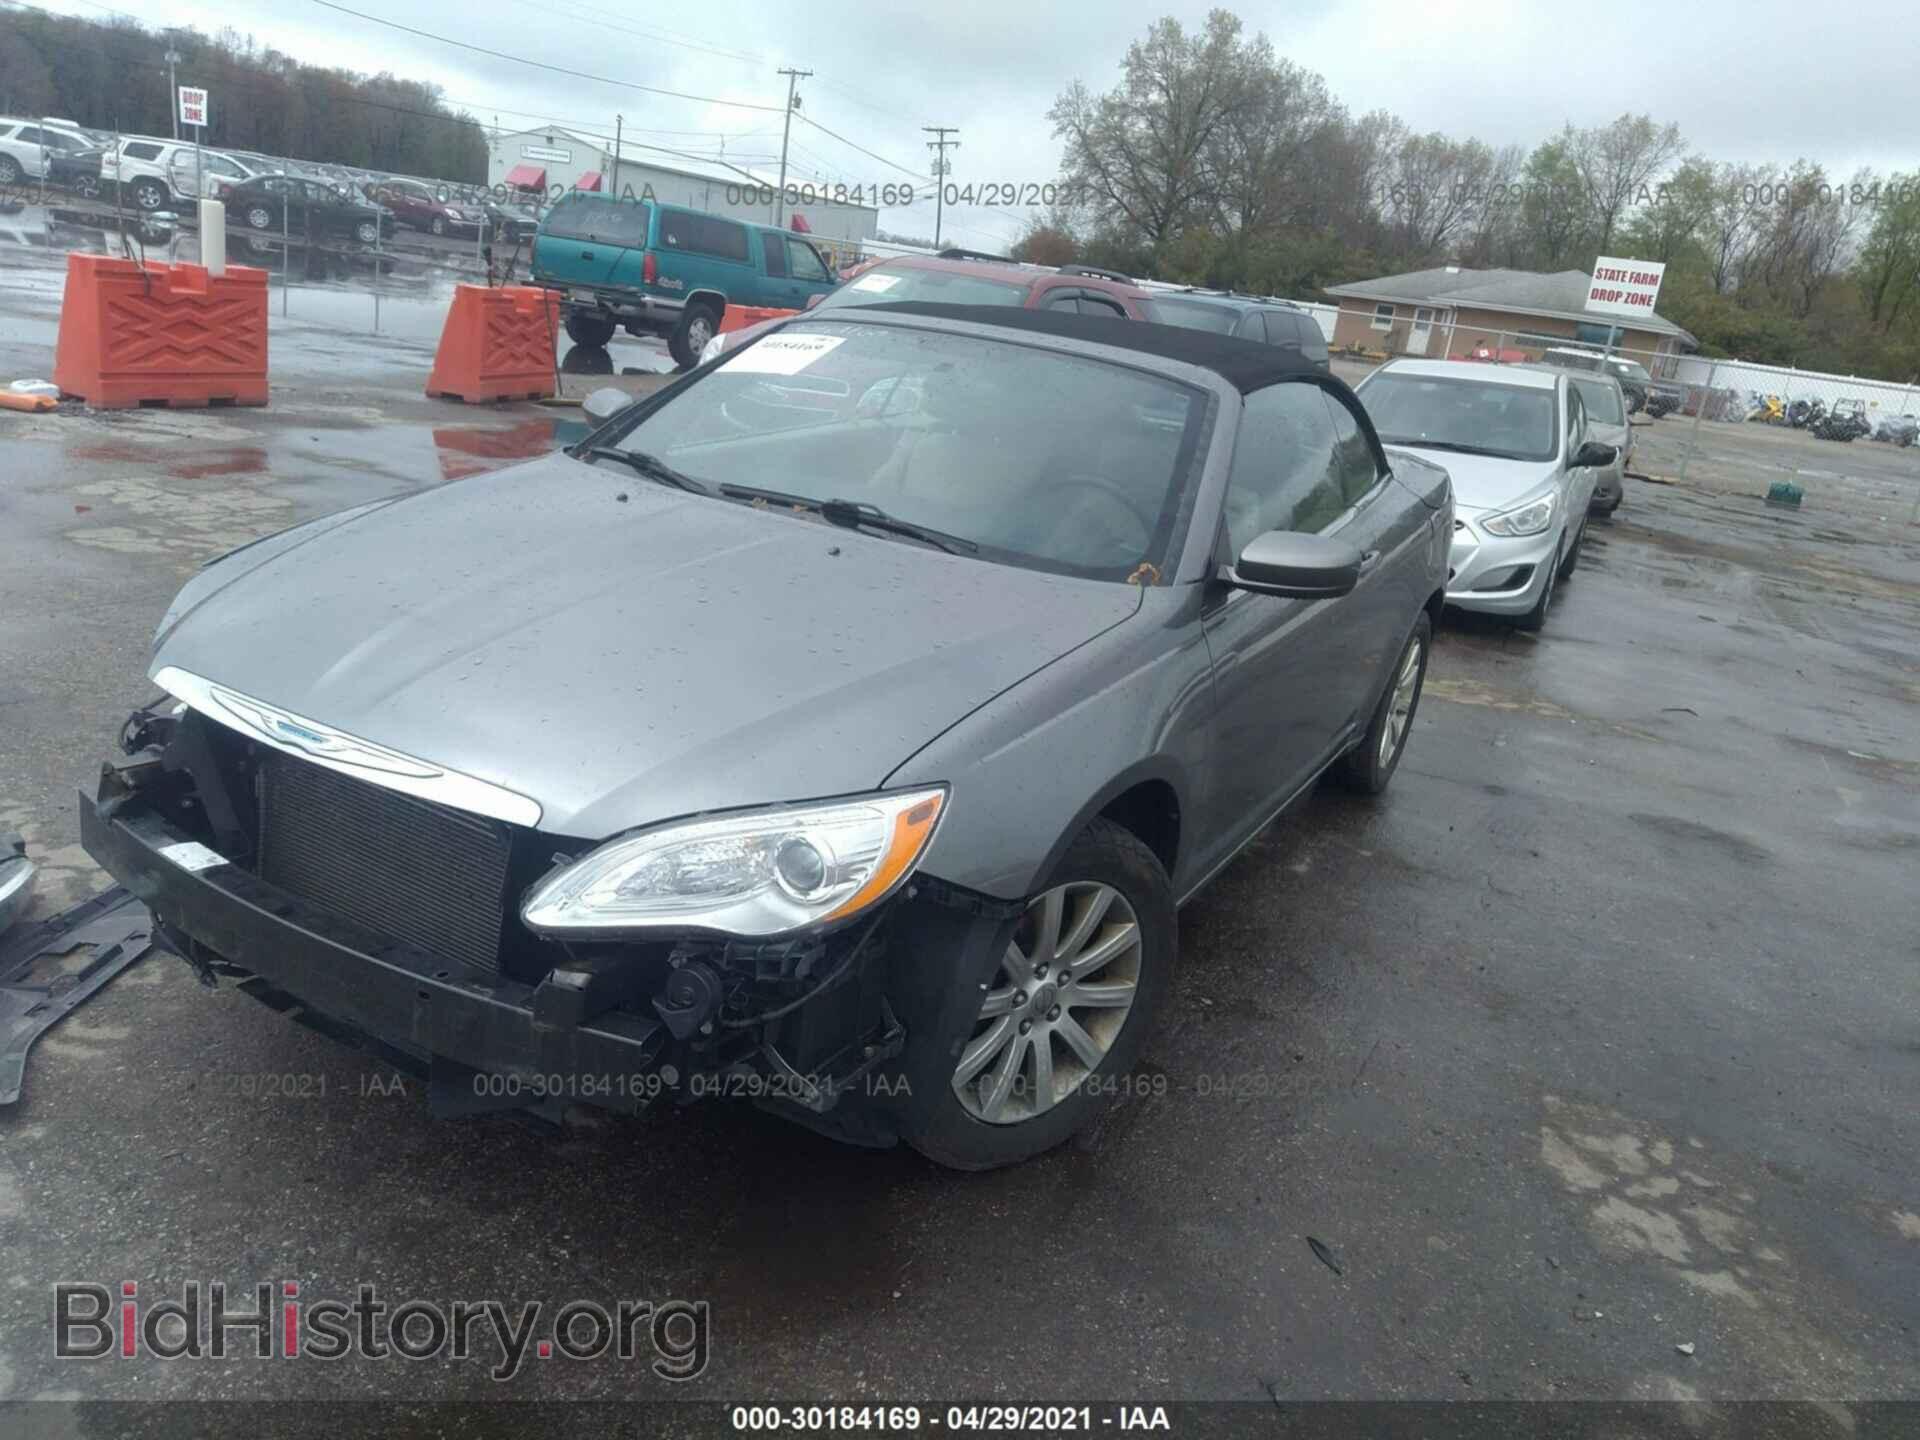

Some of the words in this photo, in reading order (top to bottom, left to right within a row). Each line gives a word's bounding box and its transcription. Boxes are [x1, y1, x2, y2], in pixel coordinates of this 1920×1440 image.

[1595, 267, 1628, 283] STATE
[1628, 271, 1660, 287] FARM
[1590, 287, 1623, 303] DROP
[1624, 291, 1656, 307] ZONE
